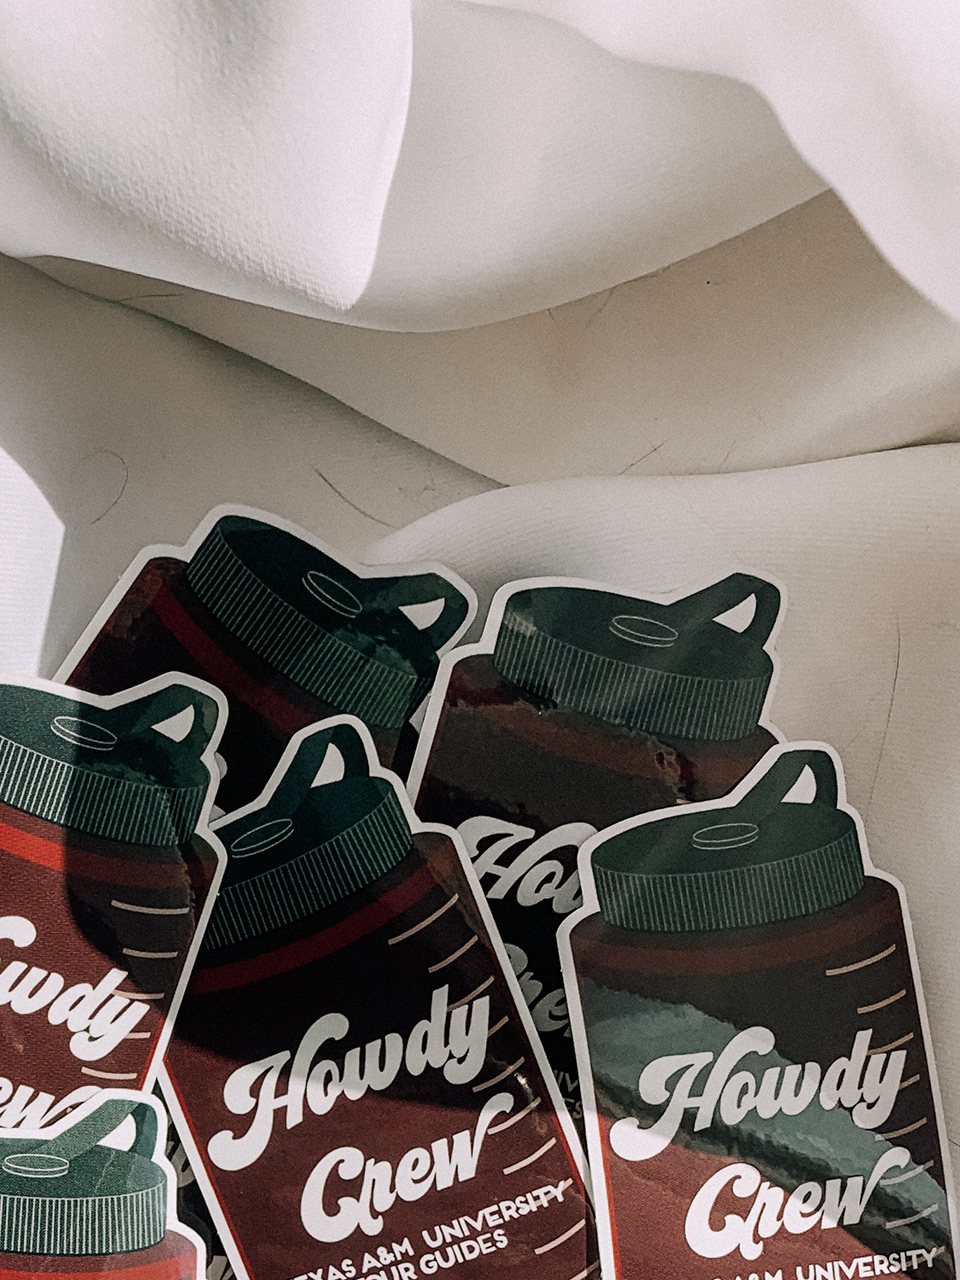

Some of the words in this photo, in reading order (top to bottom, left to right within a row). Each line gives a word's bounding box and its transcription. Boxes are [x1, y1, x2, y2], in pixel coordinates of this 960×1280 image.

[207, 984, 490, 1171] Howdy
[609, 1026, 907, 1161] Howdy
[301, 1092, 514, 1243] Crew
[361, 1237, 415, 1275] A&M
[422, 1181, 567, 1248] UNIVERSITY
[685, 1147, 910, 1260] Crew
[419, 1229, 508, 1275] GUIDES
